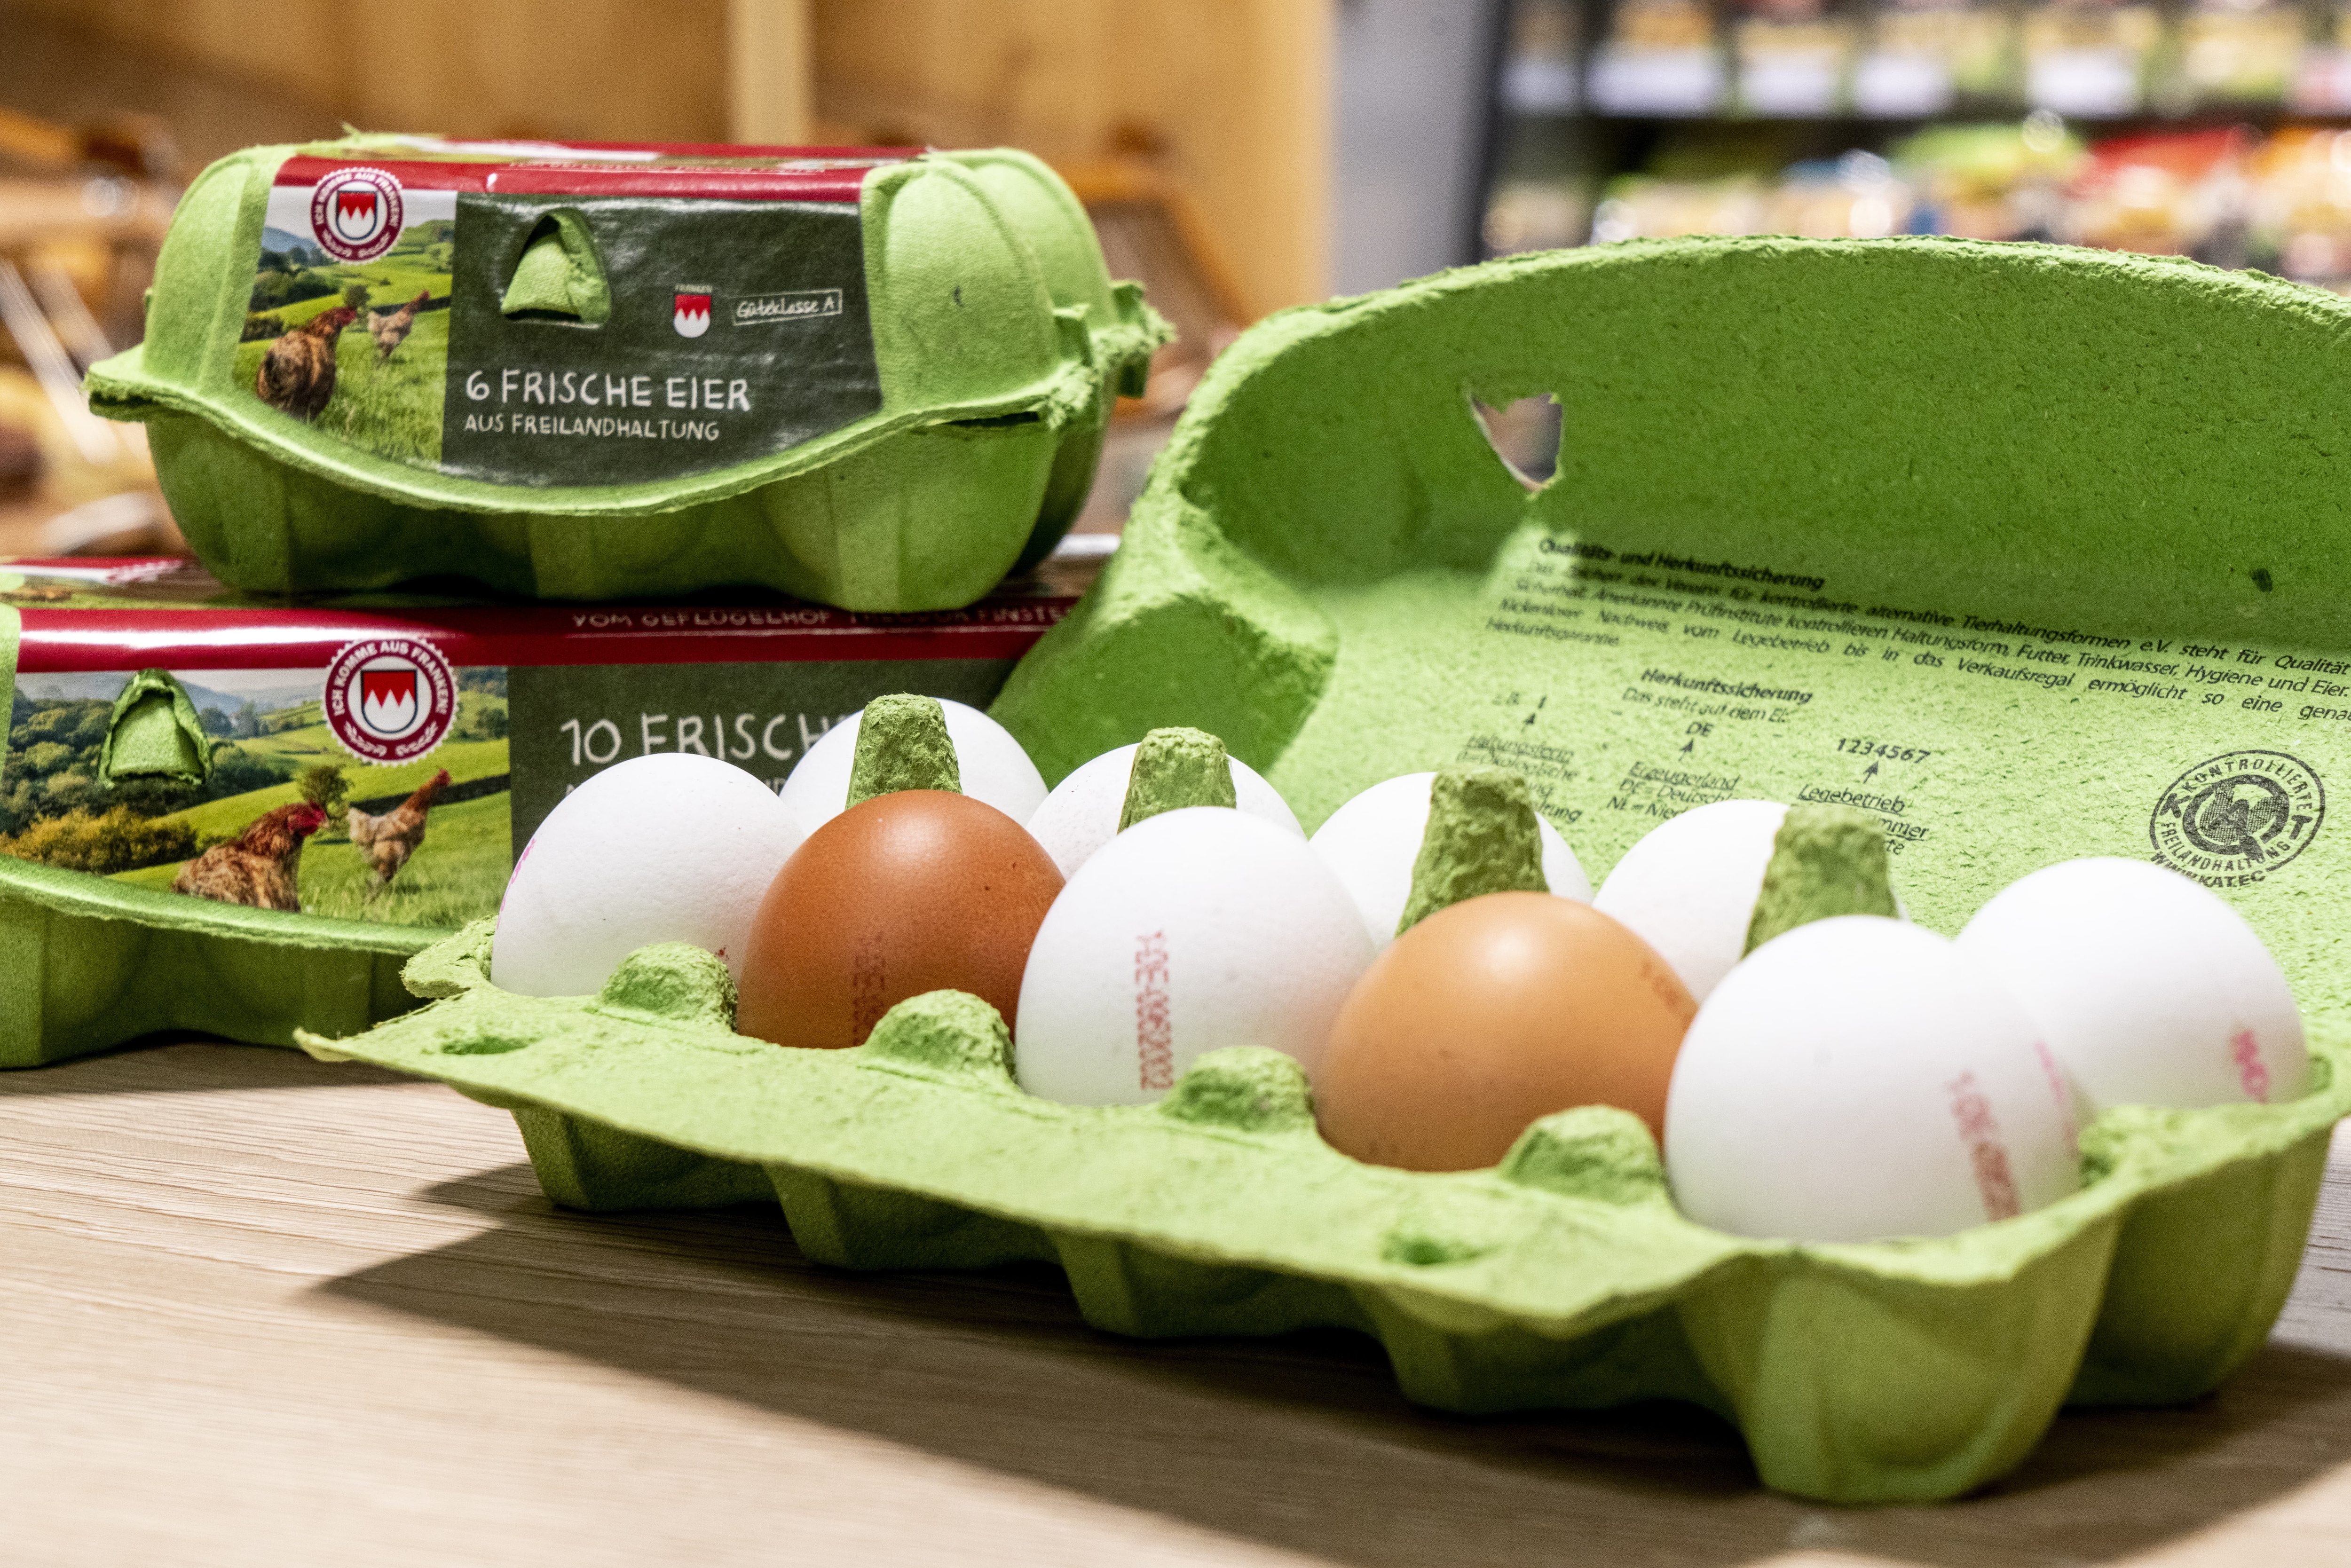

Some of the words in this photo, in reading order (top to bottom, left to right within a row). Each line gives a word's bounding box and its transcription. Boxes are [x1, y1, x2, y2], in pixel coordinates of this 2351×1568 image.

[737, 298, 819, 319] Güteklasse
[822, 295, 835, 312] A
[465, 370, 490, 401] 6
[501, 368, 652, 408] FRISCHE
[665, 377, 752, 412] EIER
[464, 413, 505, 433] AUS
[511, 413, 720, 442] FREILANDHALTUNG
[1655, 552, 1825, 592] Herkunftssicherung
[572, 613, 633, 628] VOM
[1759, 590, 1858, 614] kontrollierte
[1865, 606, 1954, 627] alternative
[1962, 614, 2131, 649] Tierhaltungsformen
[2139, 639, 2172, 653] e.V.
[2179, 645, 2229, 660] steht
[2236, 649, 2265, 665] für
[2274, 654, 2351, 675] Qualität
[333, 643, 378, 688] KOMME
[379, 640, 410, 655] AUS
[1786, 614, 1888, 639] kontrollieren
[2076, 651, 2178, 677] Trinkwasser,
[2185, 664, 2264, 686] Hygiene
[2268, 676, 2309, 692] und
[2311, 679, 2350, 697] Eier.
[1641, 668, 1814, 706] Herkunftssicherung
[1732, 629, 1830, 654] Legebetrieb
[1843, 643, 1870, 657] bis
[1881, 646, 1900, 662] in
[1913, 651, 1945, 668] das
[1957, 657, 2076, 689] Verkaufsregal
[2088, 678, 2188, 700] ermöglicht
[2202, 693, 2225, 705] so
[2241, 695, 2284, 712] eine
[331, 689, 346, 717] ICH
[1622, 686, 1651, 703] Das
[1728, 706, 1767, 721] dem
[560, 717, 622, 766] 10
[641, 711, 847, 761] FRISCH
[1685, 721, 1715, 738] DE
[1837, 737, 1932, 764] 1234567
[1797, 783, 1905, 816] Legebetrieb
[2161, 822, 2291, 872] FREILANDHALTUNG
